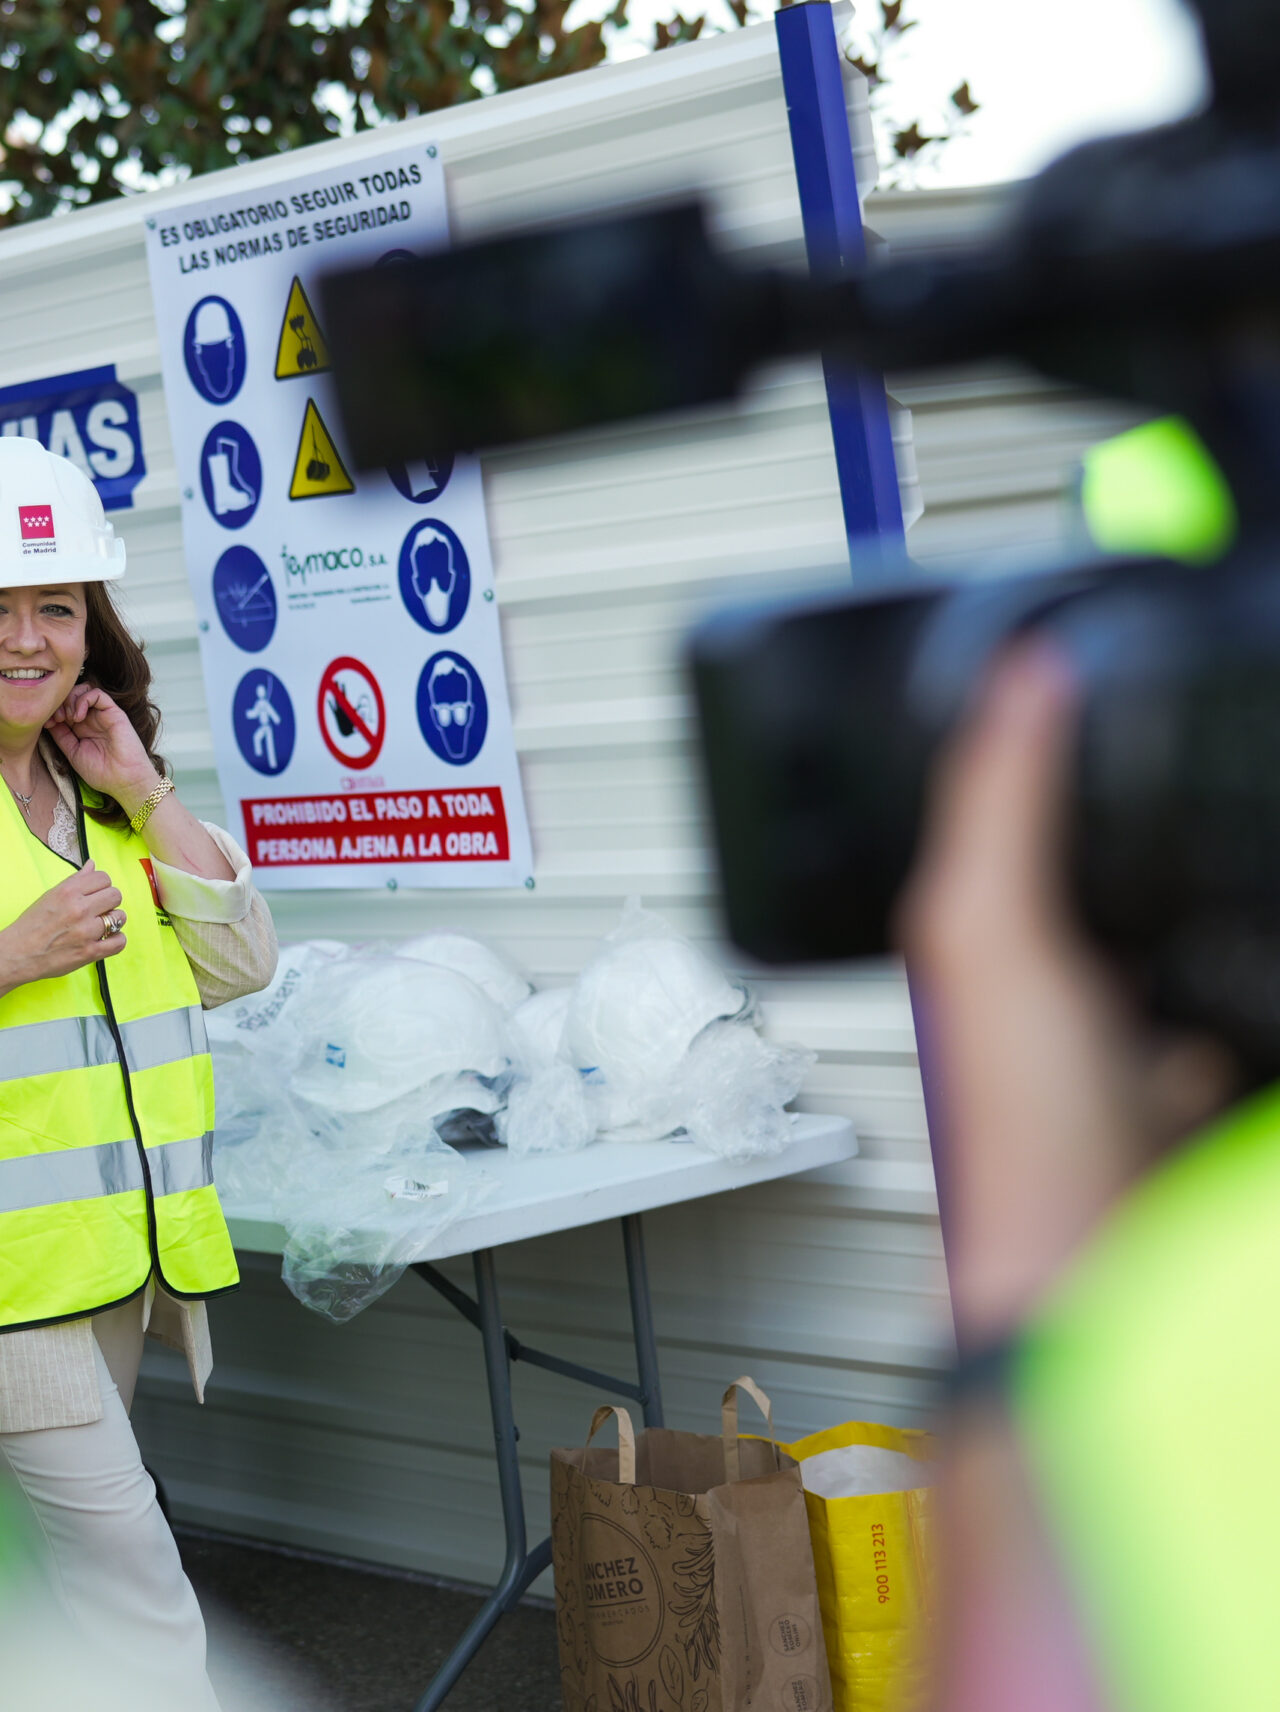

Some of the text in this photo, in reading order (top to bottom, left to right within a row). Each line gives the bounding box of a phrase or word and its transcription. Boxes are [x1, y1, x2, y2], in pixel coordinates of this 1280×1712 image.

[160, 164, 422, 248] ES OBLIGATORIO SEGUIR TODAS
[179, 200, 412, 275] LAS NORMAS DE SEGURIDAD
[251, 793, 495, 826] PROHIBIDO EL PASO A TODA
[256, 831, 499, 863] PERSONA AJENA A LA OBRA
[584, 1556, 639, 1580] NCHEZ
[871, 1523, 891, 1604] 900 113 213
[585, 1578, 644, 1601] OMERO
